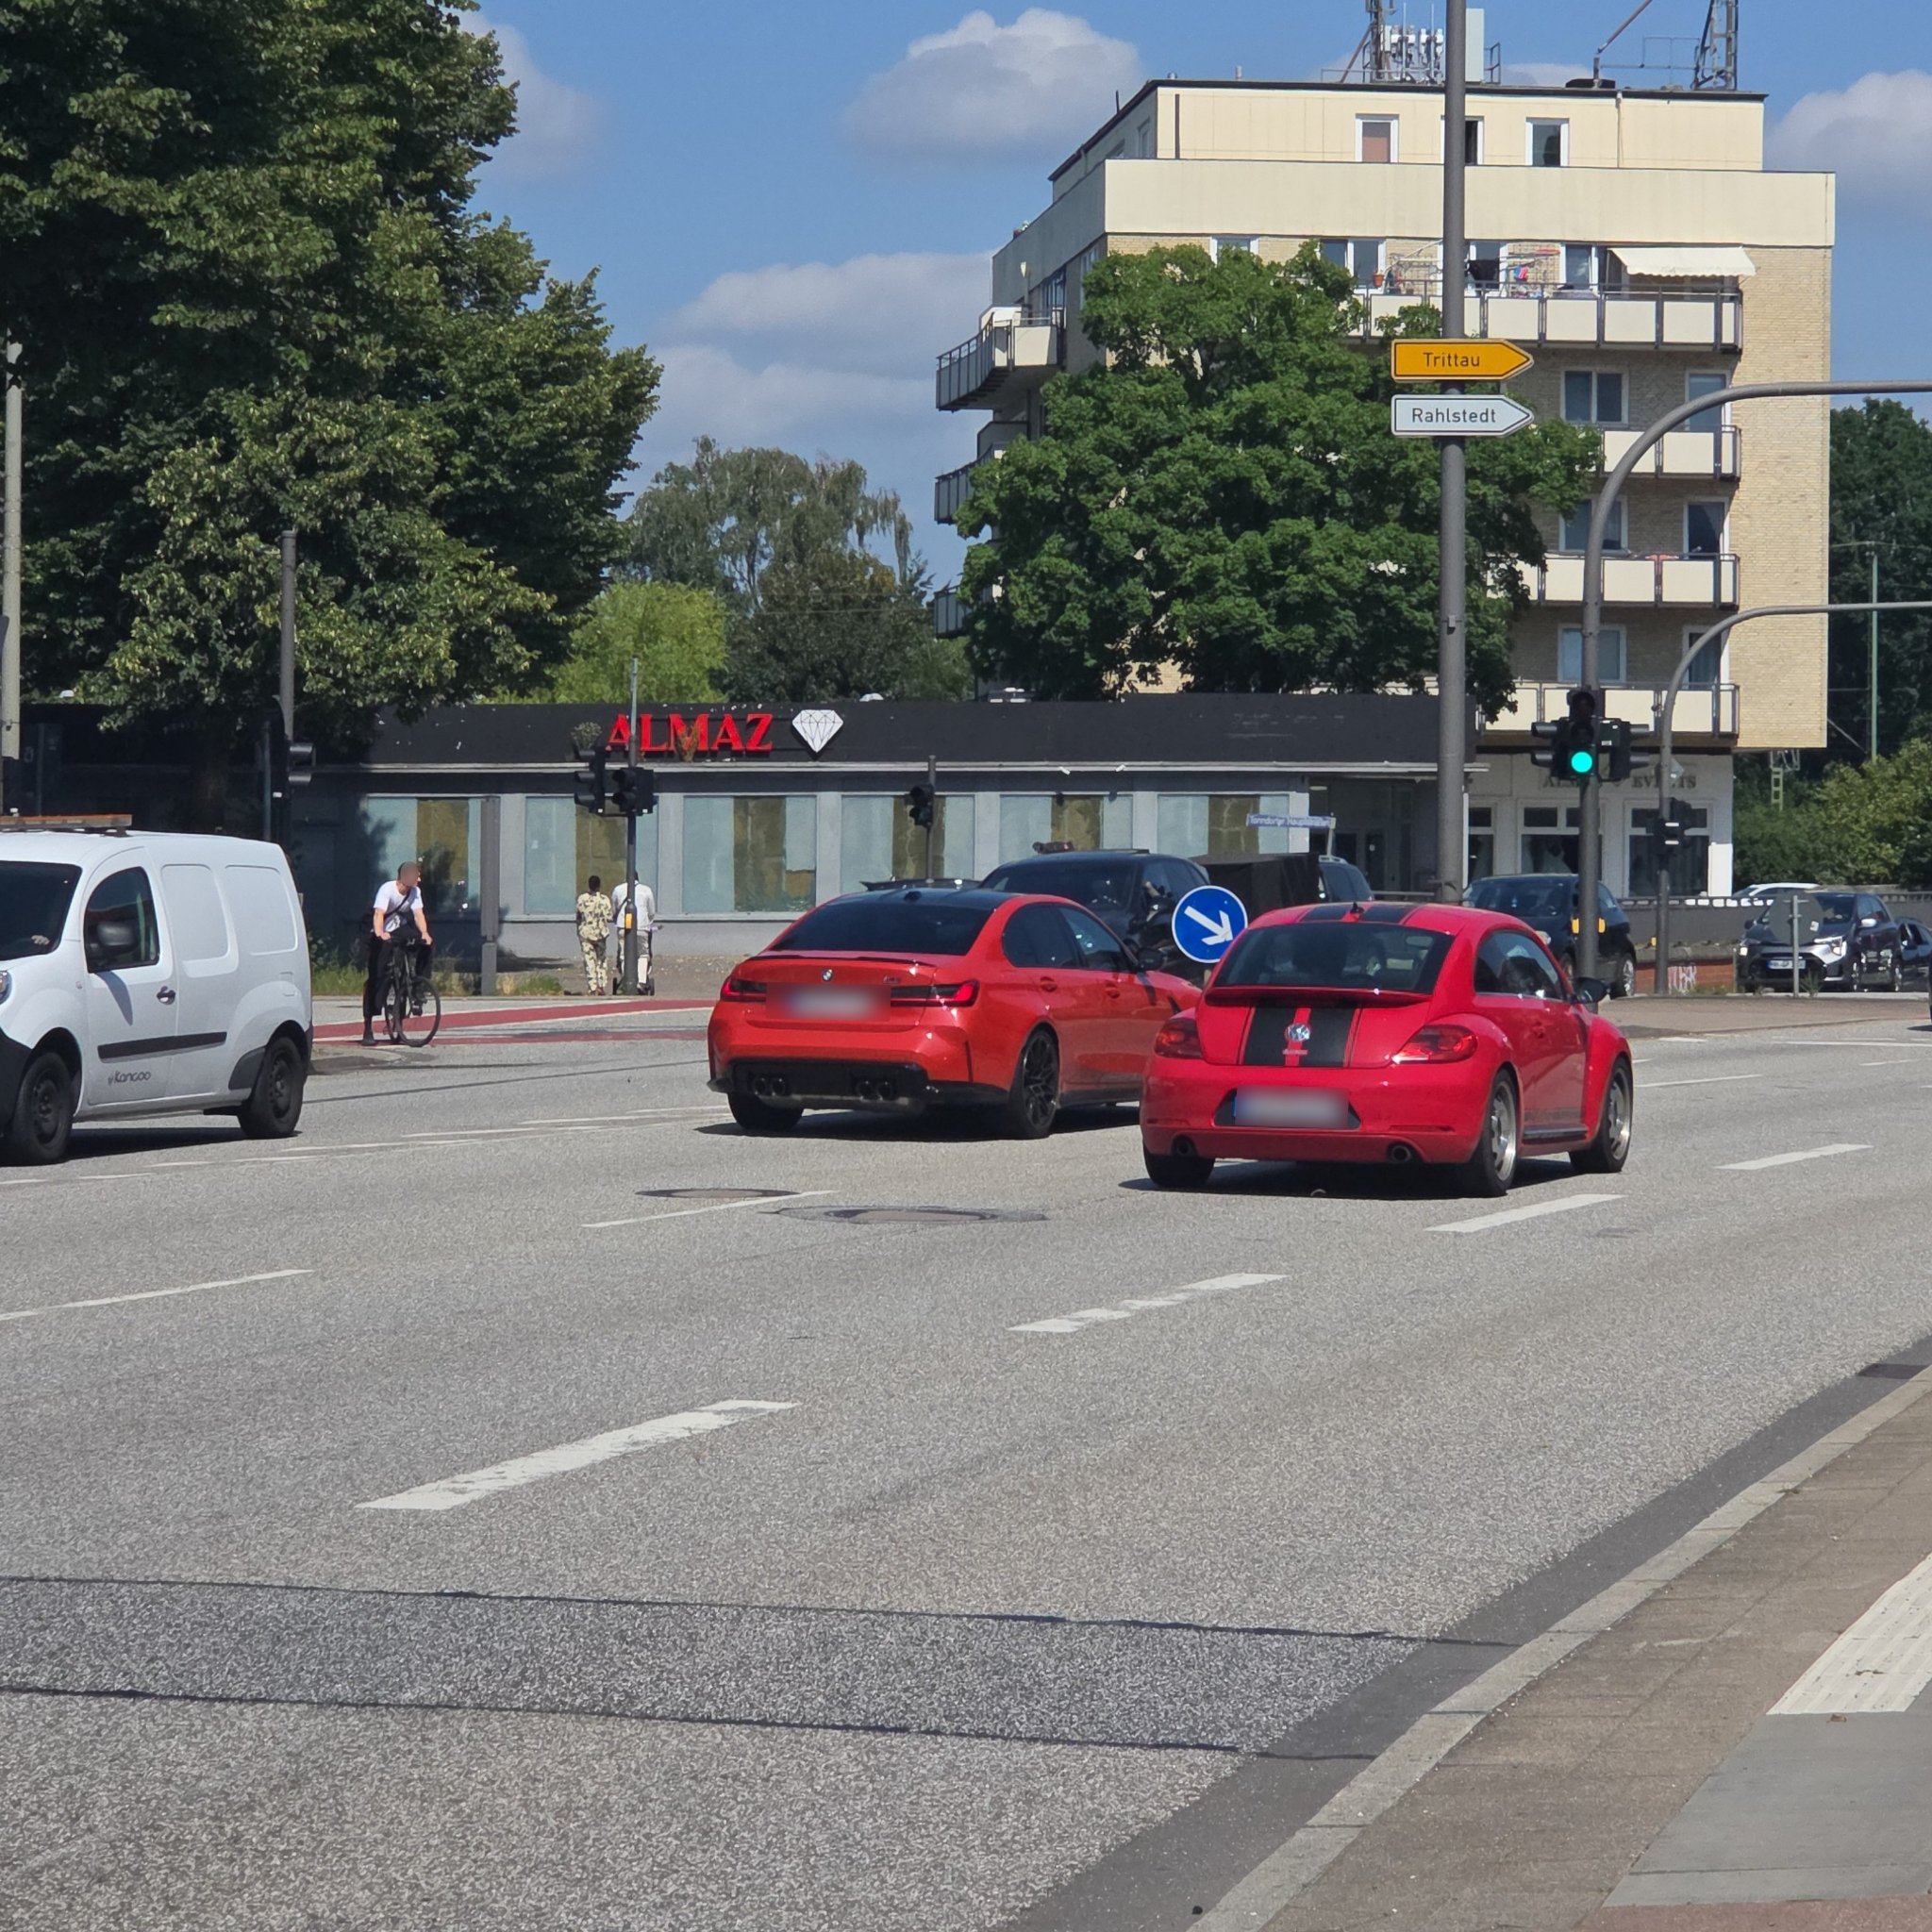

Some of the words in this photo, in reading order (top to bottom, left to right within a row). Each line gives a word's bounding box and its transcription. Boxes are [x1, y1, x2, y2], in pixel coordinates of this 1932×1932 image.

[1423, 352, 1481, 367] Trittau
[1411, 408, 1496, 423] Rahlstedt
[606, 713, 774, 752] ALMAZ
[1632, 775, 1697, 788] EVTS
